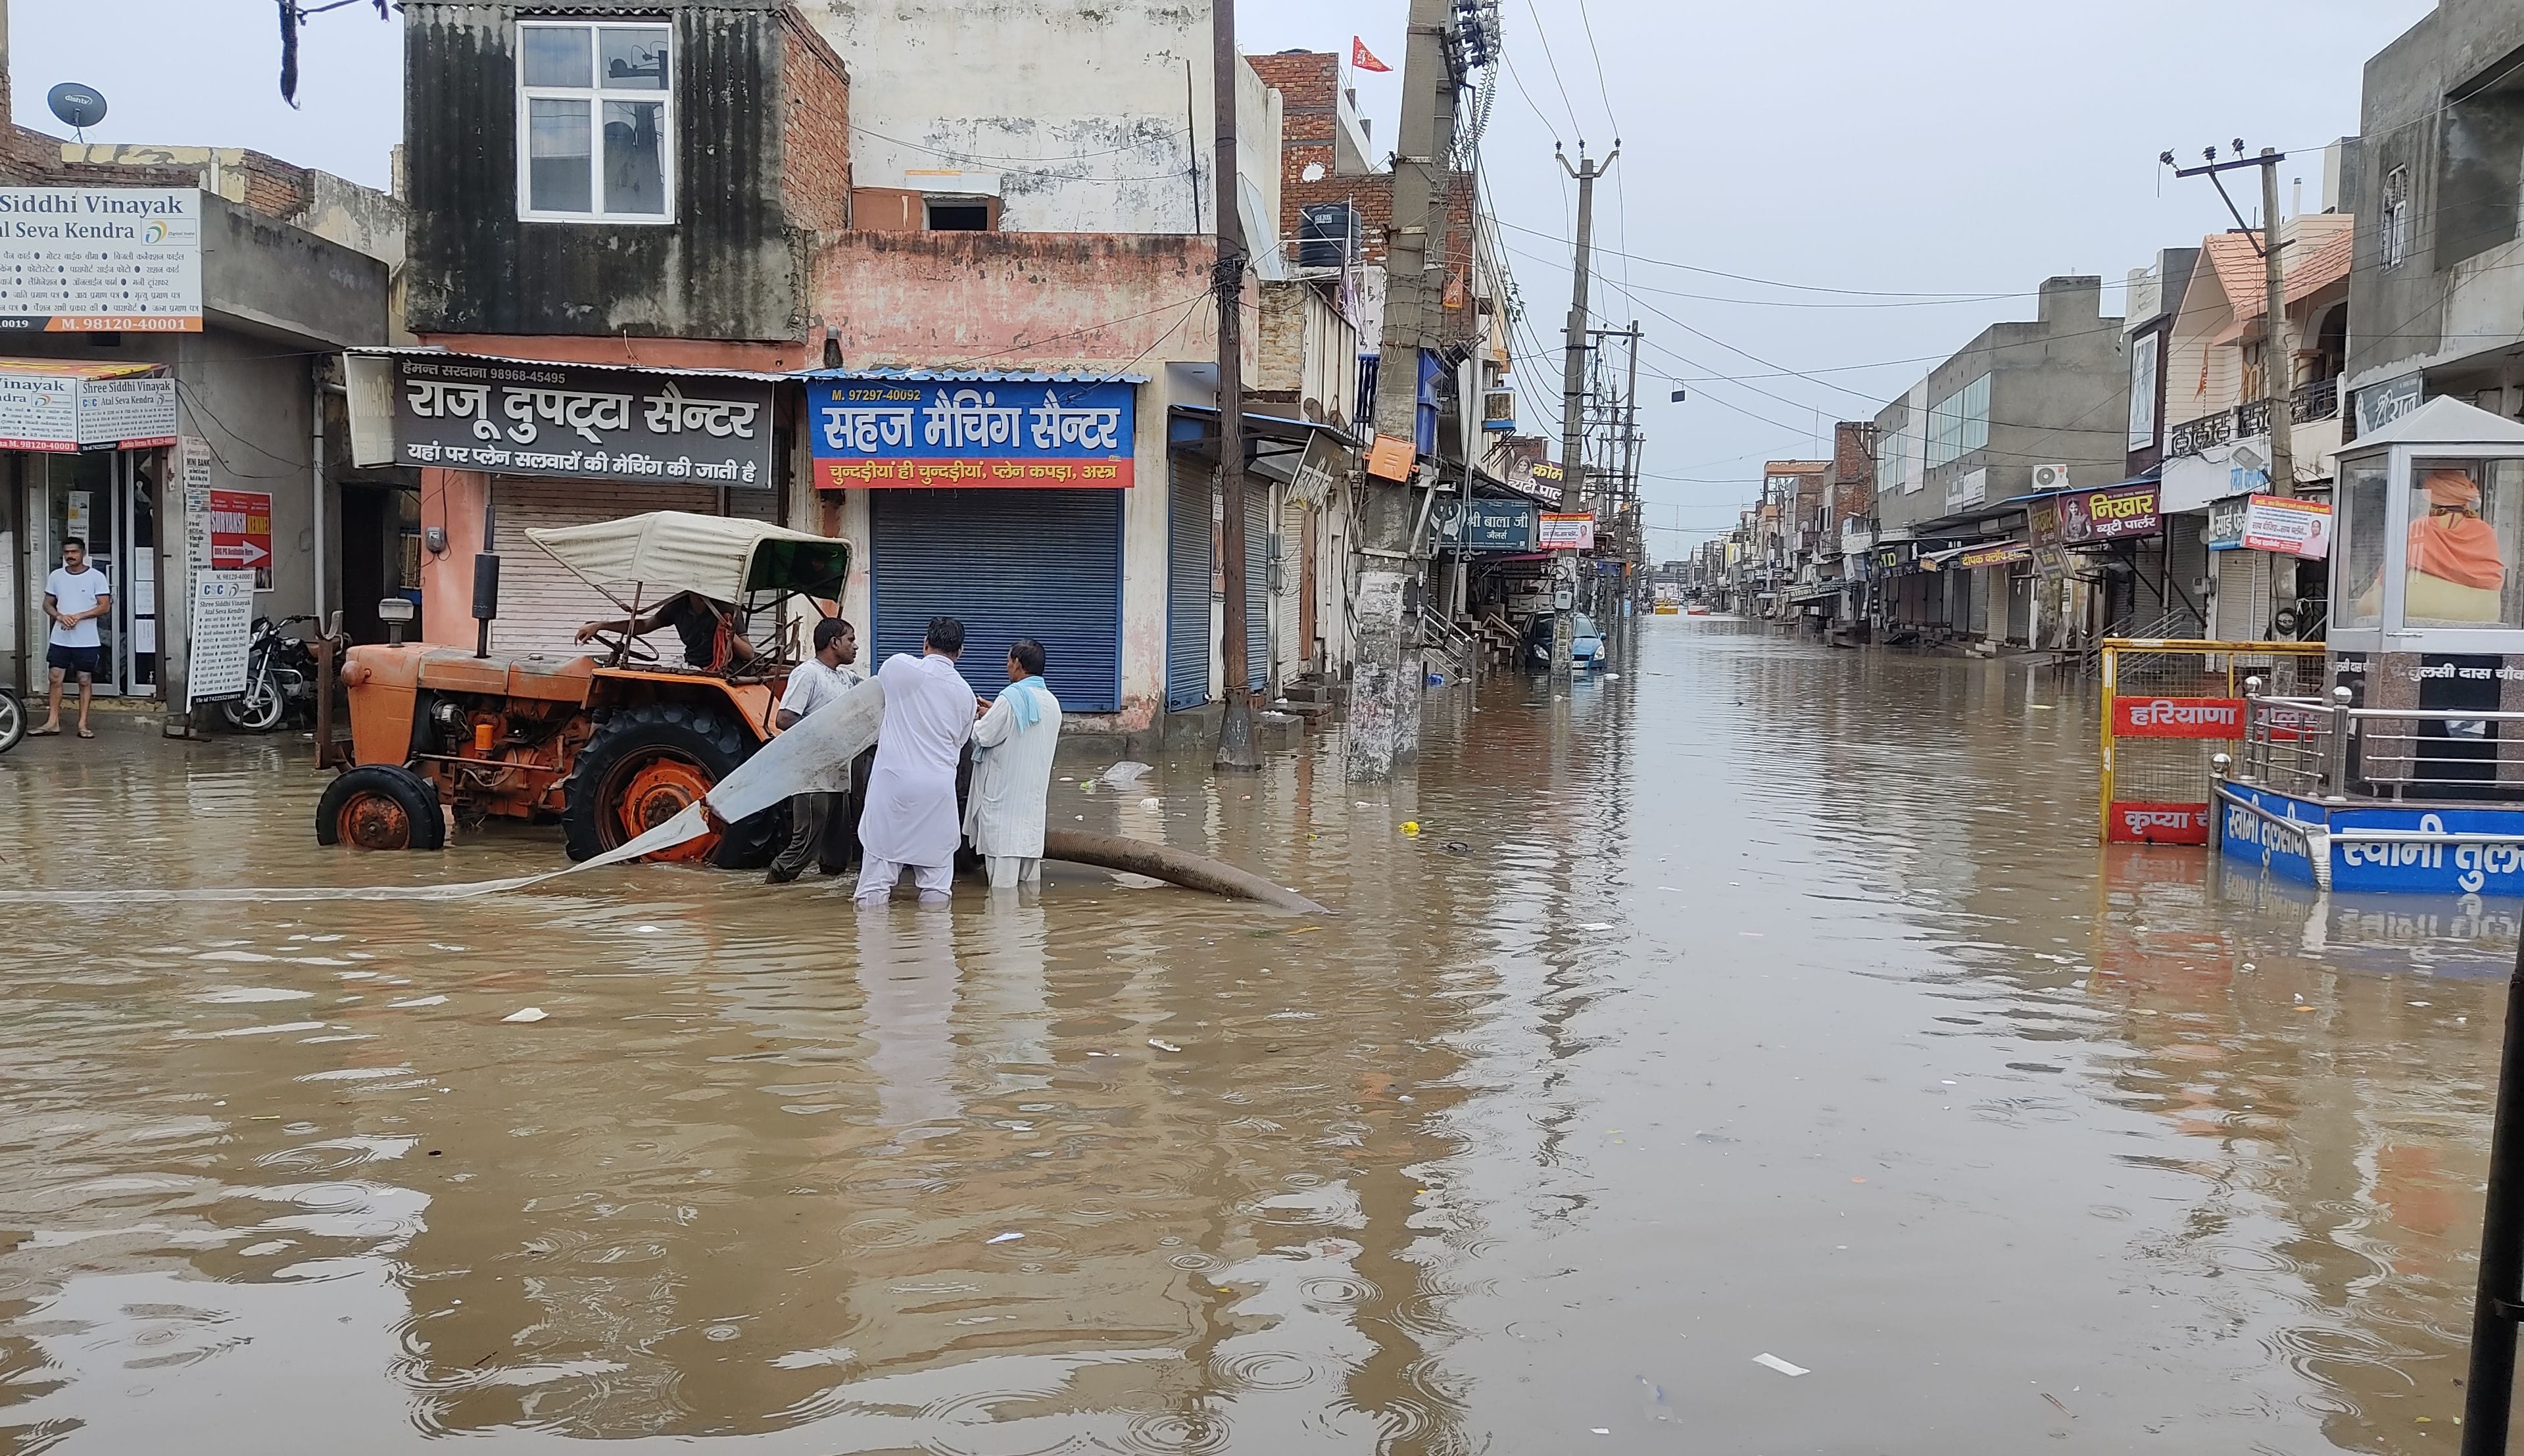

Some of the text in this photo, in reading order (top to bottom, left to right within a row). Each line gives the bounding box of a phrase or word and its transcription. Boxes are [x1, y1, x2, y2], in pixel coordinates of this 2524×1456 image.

[0, 195, 183, 218] Siddhi Vinayak
[16, 222, 59, 238] Seva
[64, 222, 135, 238] Kendra
[61, 318, 186, 329] M. 98120-40001
[402, 359, 566, 383] हेमन्त सरदाना 98968-45495
[83, 380, 171, 394] Shree Siddhi Vinayak
[831, 389, 921, 402] M. 97297-40092
[101, 397, 114, 406] Atal
[115, 396, 130, 404] Seva
[132, 395, 155, 404] Kendra
[406, 379, 760, 444] राजू दुपट्टा सैन्टर
[821, 387, 1121, 452] सहज मैचिंग सैन्टर
[20, 441, 75, 450] 98120-40001
[407, 441, 757, 483] यहां पर प्लेन सलवारों की मेचिंग की जाती है
[897, 460, 915, 479] ही
[991, 460, 1025, 479] प्लेन
[1029, 465, 1077, 483] कपड़ा,
[1081, 465, 1118, 479] अस्त्र
[2089, 493, 2154, 521] निखार
[211, 510, 247, 534] SURYANSH
[1484, 516, 1511, 527] बाला
[1514, 512, 1529, 528] जी
[2096, 514, 2156, 536] ब्यूटी पार्लर
[2459, 667, 2492, 680] दास
[2129, 699, 2237, 726] हरियाणा
[2124, 811, 2190, 835] कृप्या
